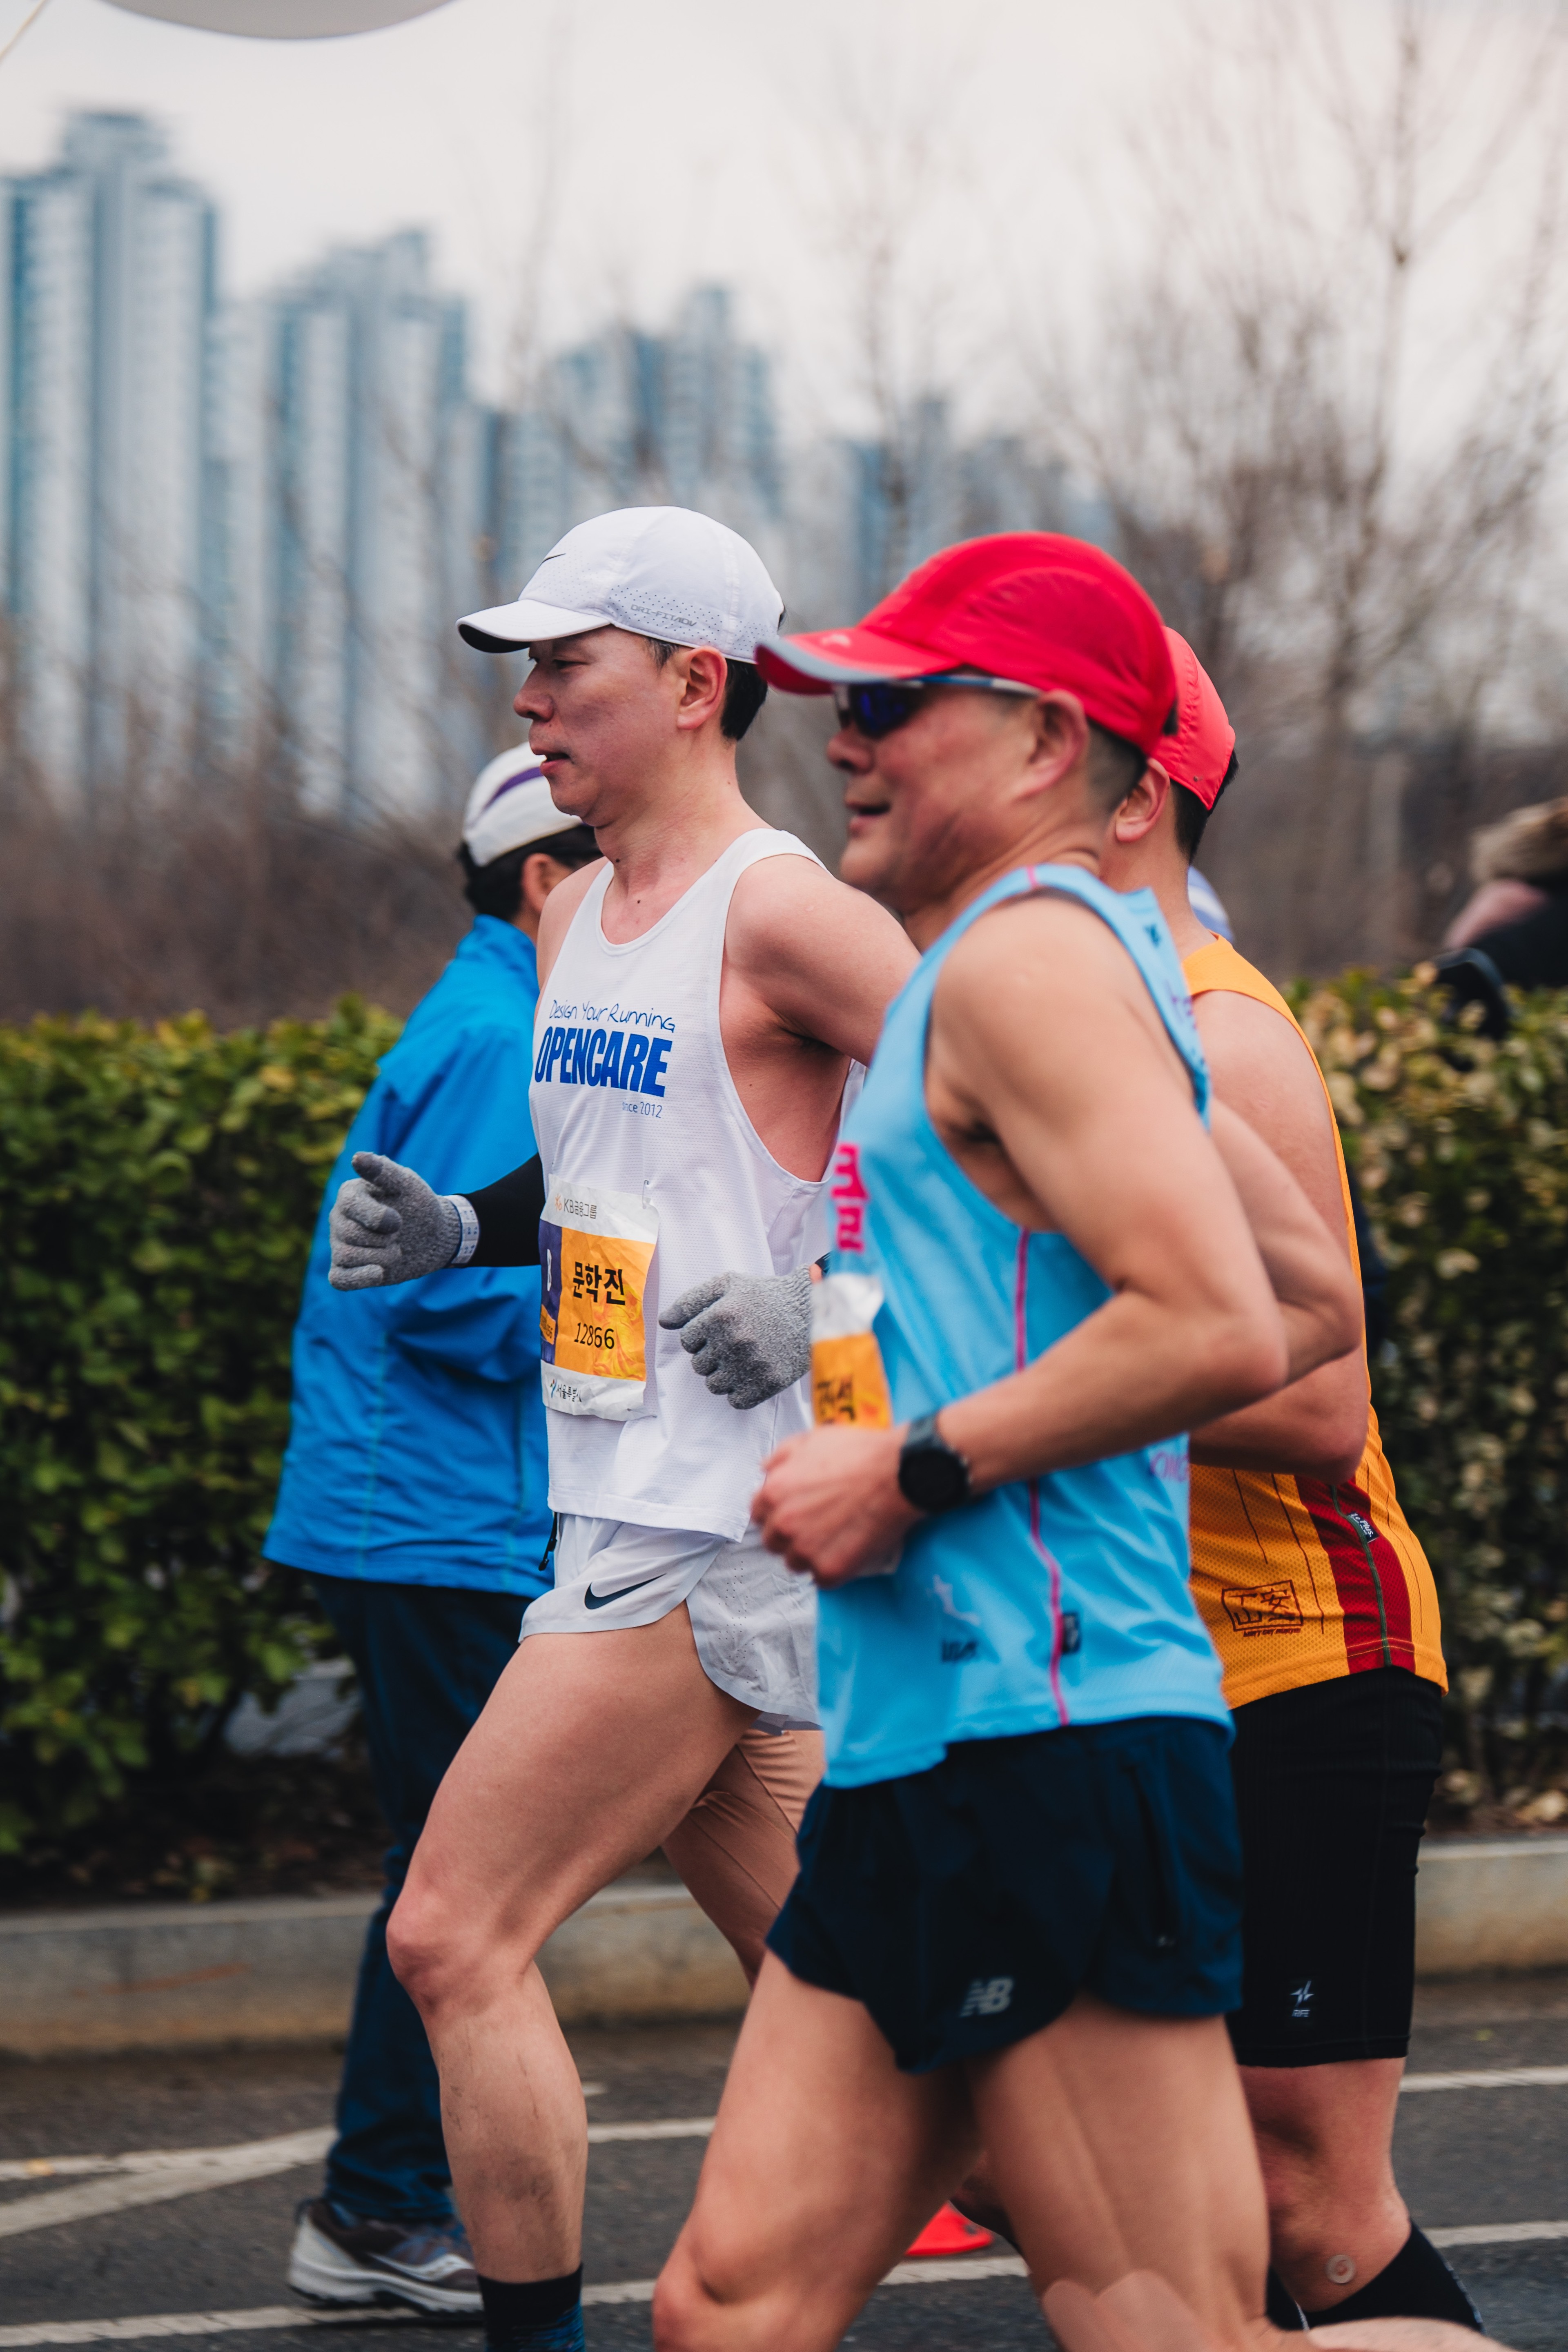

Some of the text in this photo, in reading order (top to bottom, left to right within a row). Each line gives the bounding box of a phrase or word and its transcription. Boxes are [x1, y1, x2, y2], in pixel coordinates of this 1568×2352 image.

[582, 1000, 608, 1022] Your
[535, 1026, 673, 1098] OPENCARE
[640, 1101, 662, 1118] 2012
[572, 1261, 626, 1306] 문학진
[574, 1322, 615, 1350] 12866
